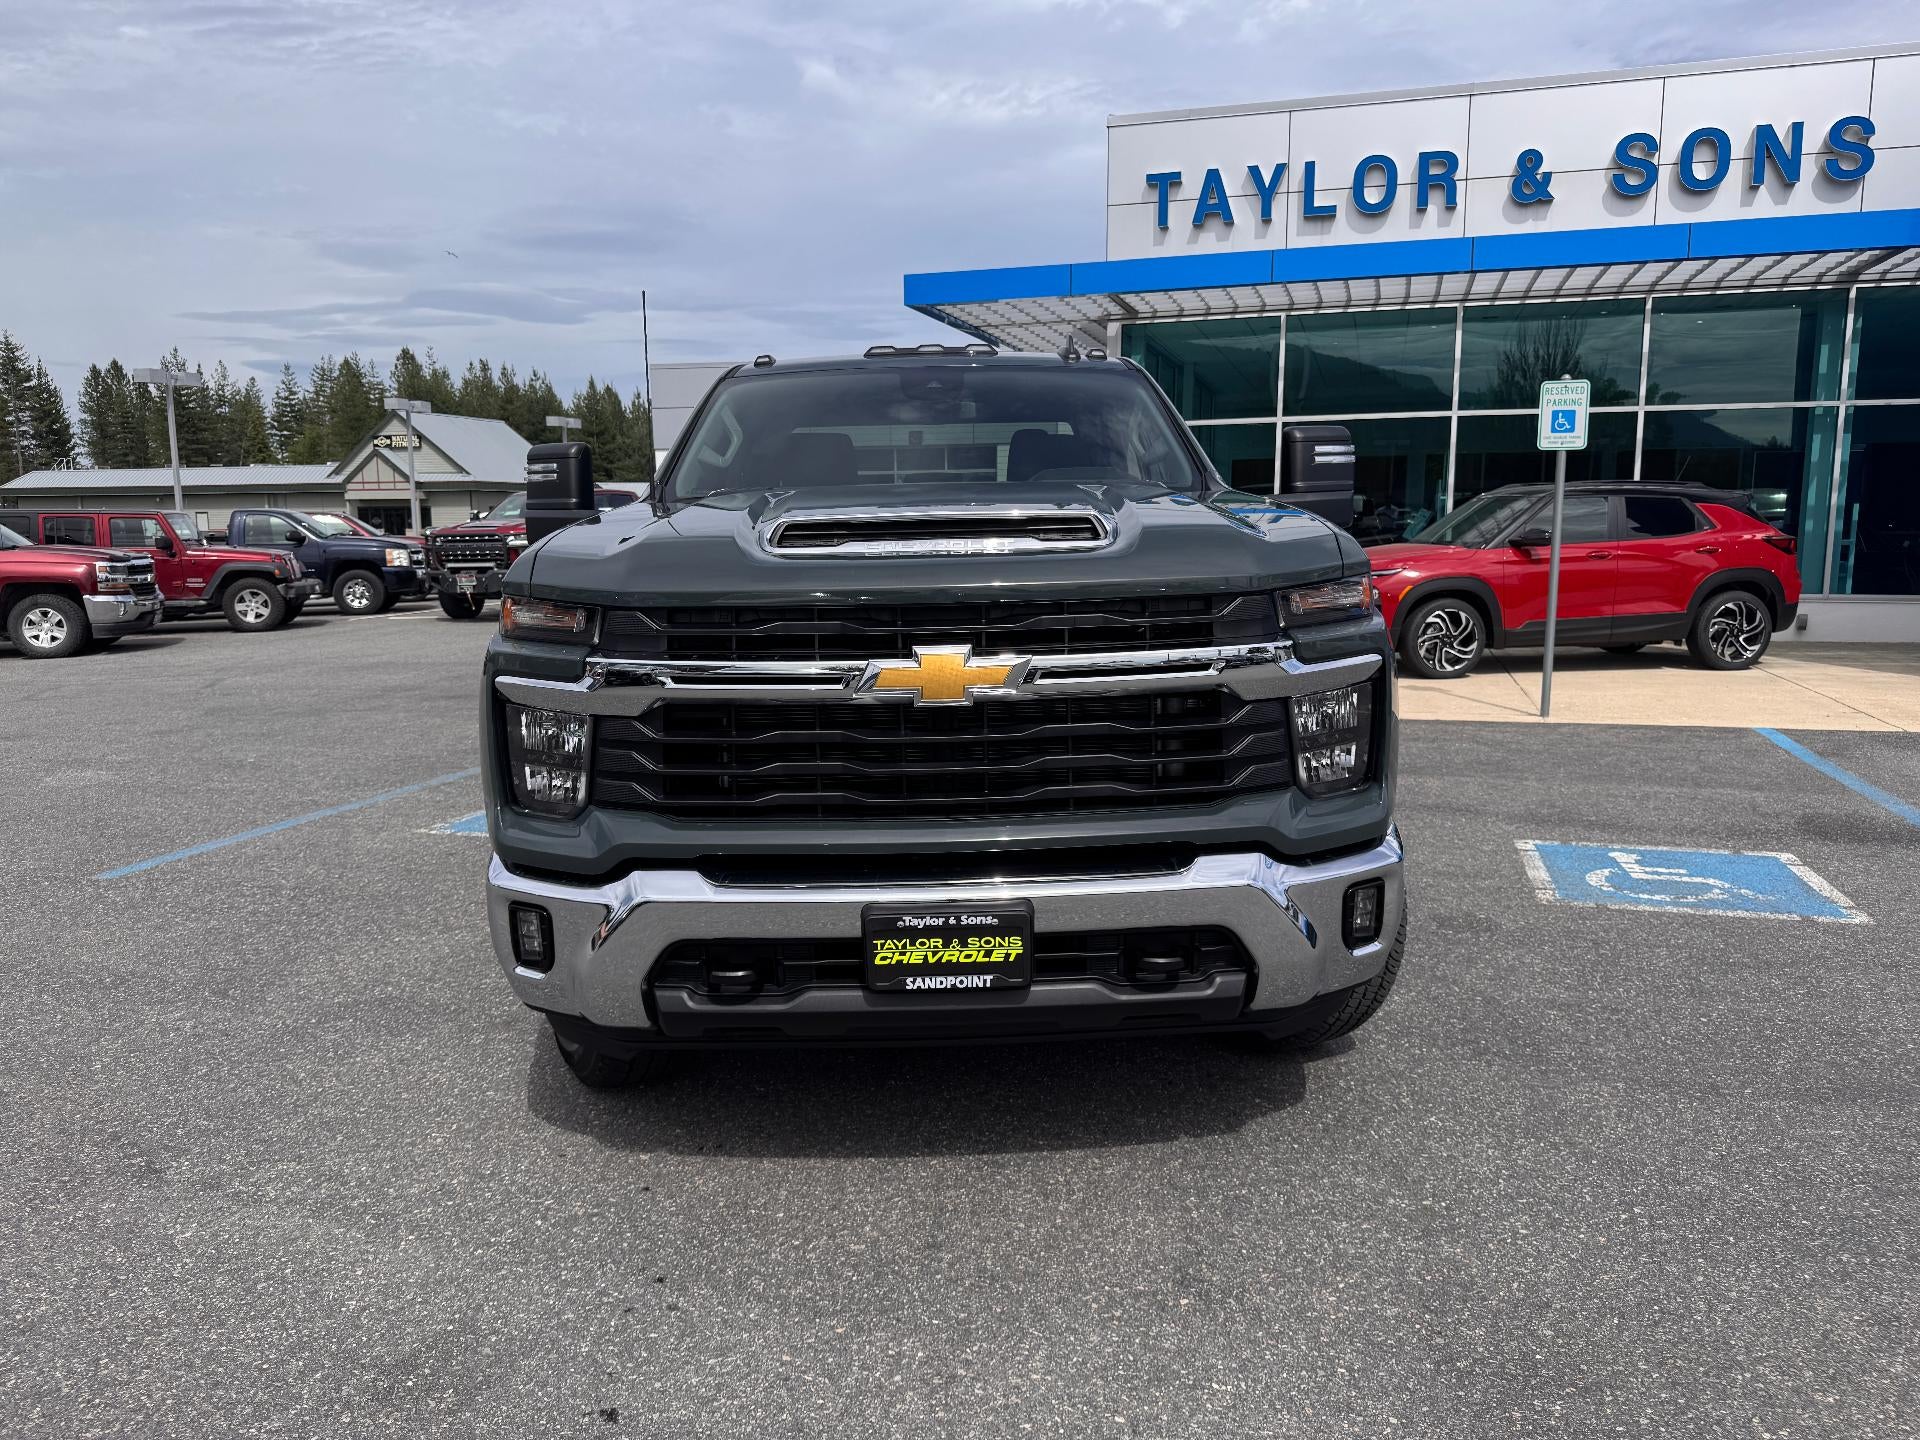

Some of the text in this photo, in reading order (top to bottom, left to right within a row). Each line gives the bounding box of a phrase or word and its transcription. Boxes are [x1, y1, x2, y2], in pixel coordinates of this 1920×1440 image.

[1146, 114, 1876, 230] TAYLOR & SONS
[1545, 386, 1585, 395] RESERVED
[1546, 398, 1583, 407] PARKING
[903, 915, 993, 929] Taylor & Sons
[873, 936, 1023, 950] TAYLOR & SONS
[874, 950, 1023, 965] CHEVROLET
[905, 975, 994, 990] SANDPOINT
